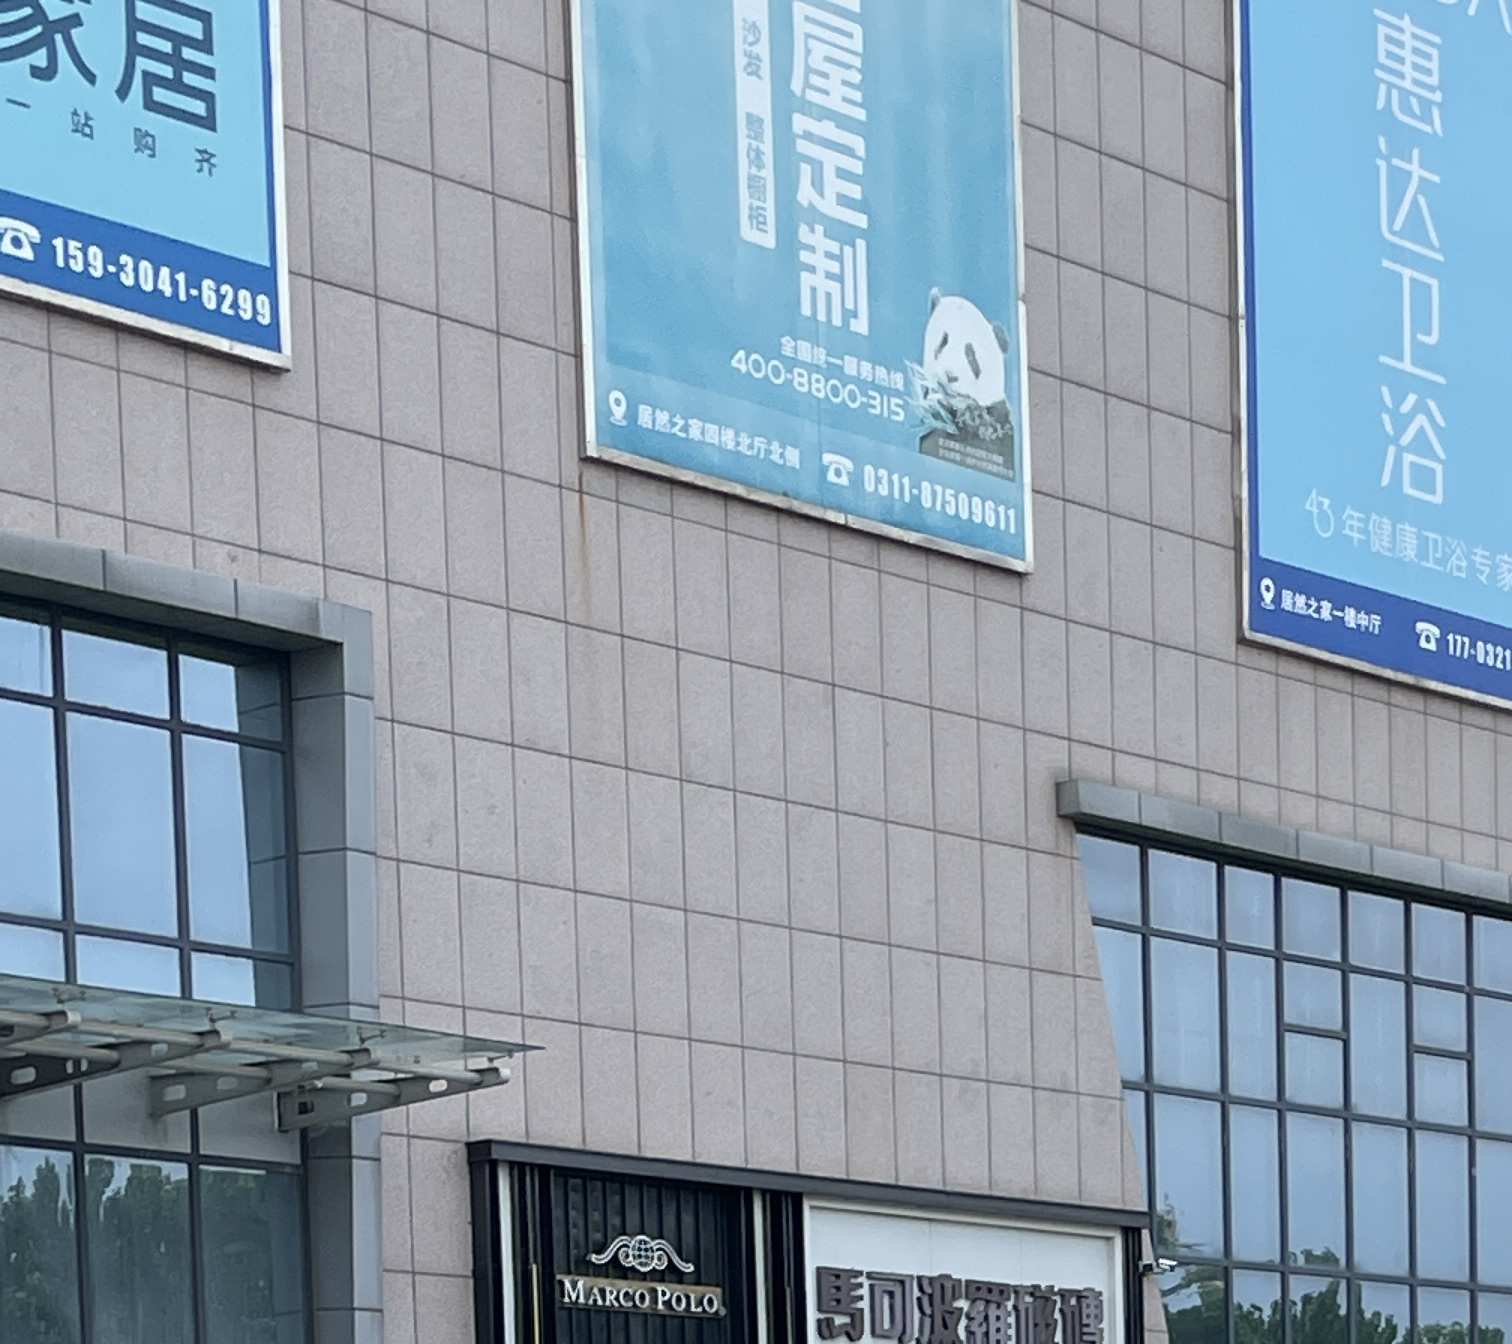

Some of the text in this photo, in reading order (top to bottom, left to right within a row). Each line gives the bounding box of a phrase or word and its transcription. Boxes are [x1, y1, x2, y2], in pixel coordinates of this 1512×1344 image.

[5, 97, 217, 177] 一站购齐
[790, 0, 869, 336] 屋定制
[52, 236, 271, 326] 159-3041-6299
[1374, 8, 1447, 505] 惠达卫浴
[731, 349, 905, 422] 400-8800-315
[863, 464, 1016, 534] 0311-87509611
[563, 1278, 719, 1314] MARCO POLO
